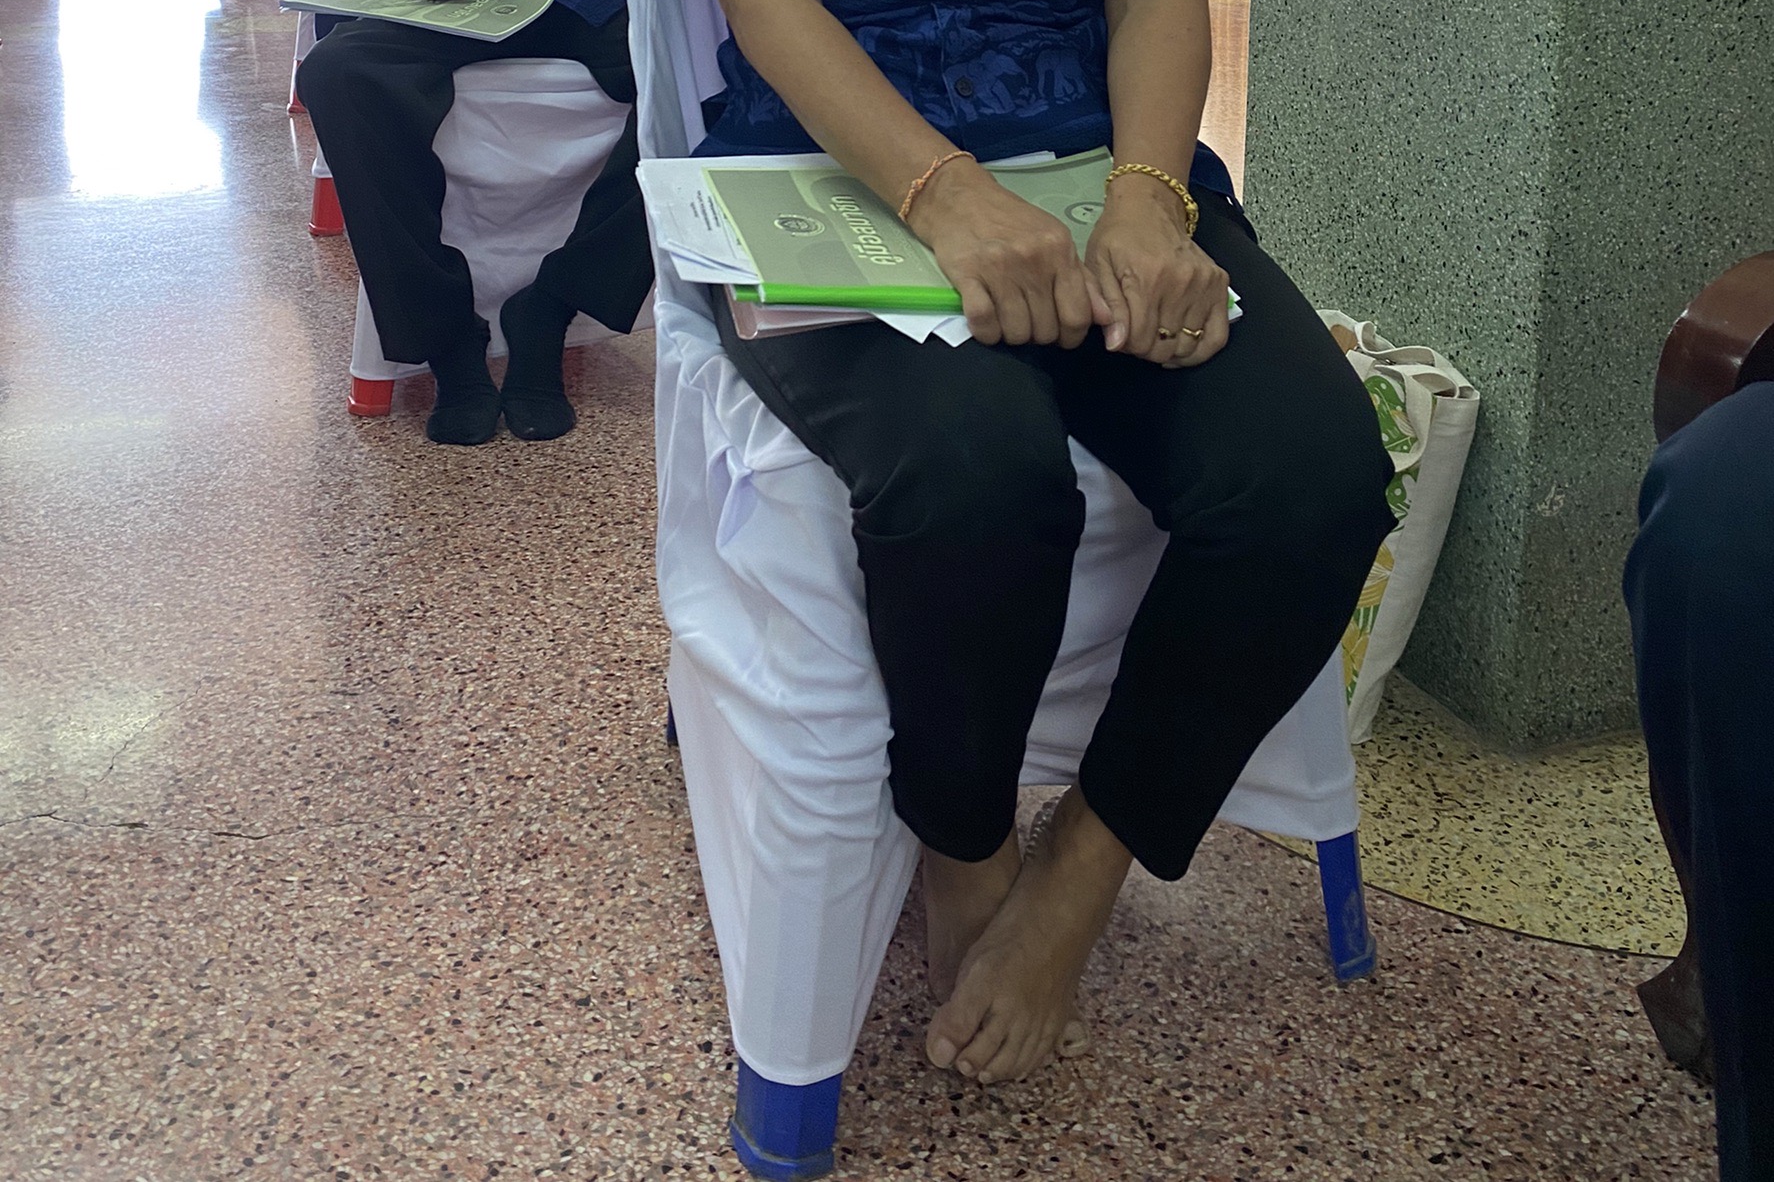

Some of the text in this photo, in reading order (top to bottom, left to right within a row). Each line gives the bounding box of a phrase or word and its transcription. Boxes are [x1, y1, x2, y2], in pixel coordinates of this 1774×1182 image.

[830, 195, 904, 265] คู่มือสมาชิก
